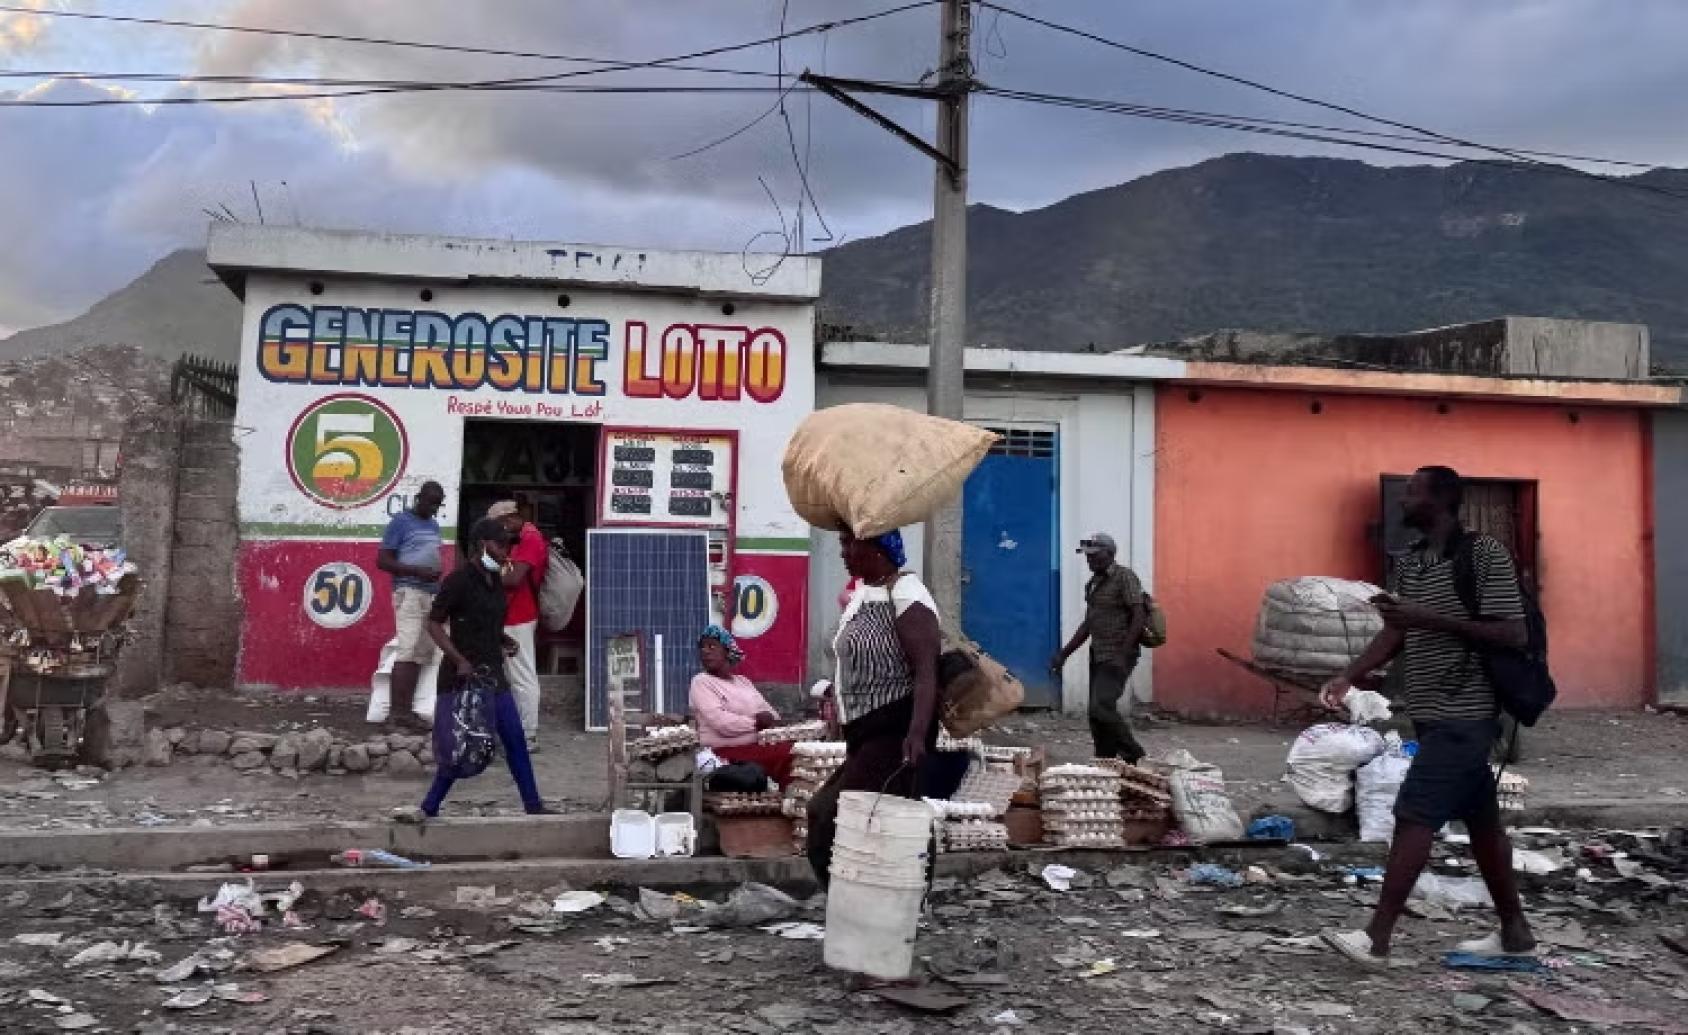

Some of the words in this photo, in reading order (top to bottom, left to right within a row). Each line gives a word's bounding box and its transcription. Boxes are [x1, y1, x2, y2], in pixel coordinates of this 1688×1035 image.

[257, 303, 610, 395] GENEROSITE
[622, 319, 787, 403] LOTTO
[311, 413, 384, 502] 5
[310, 570, 364, 615] 50
[734, 582, 764, 620] 0
